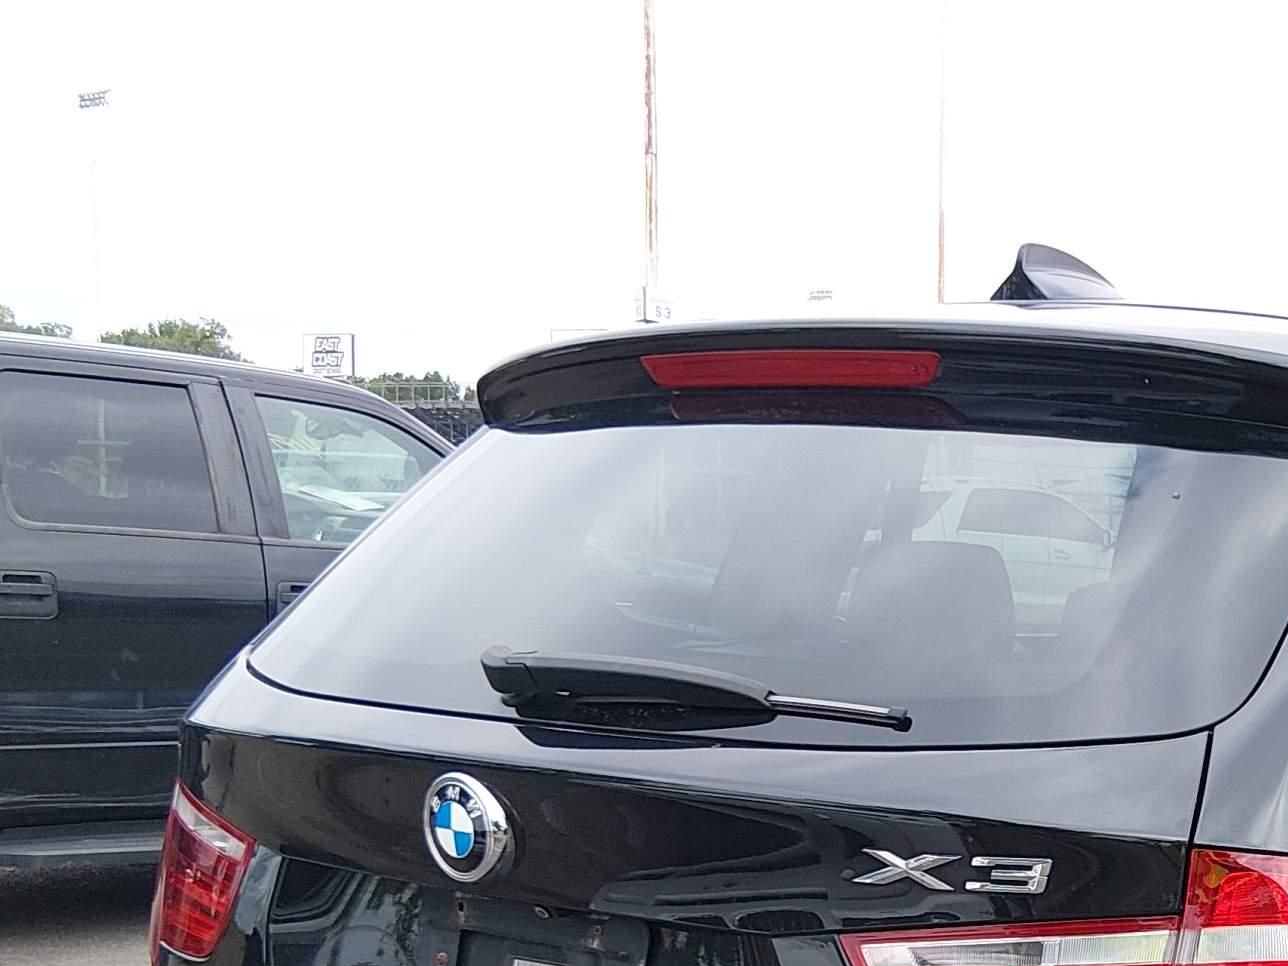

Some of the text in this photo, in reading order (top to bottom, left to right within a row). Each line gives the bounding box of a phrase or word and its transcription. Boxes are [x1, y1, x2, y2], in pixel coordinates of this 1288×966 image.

[315, 336, 341, 351] EAST
[312, 351, 344, 367] COAST
[430, 785, 482, 819] BMW
[851, 848, 1053, 895] X3
